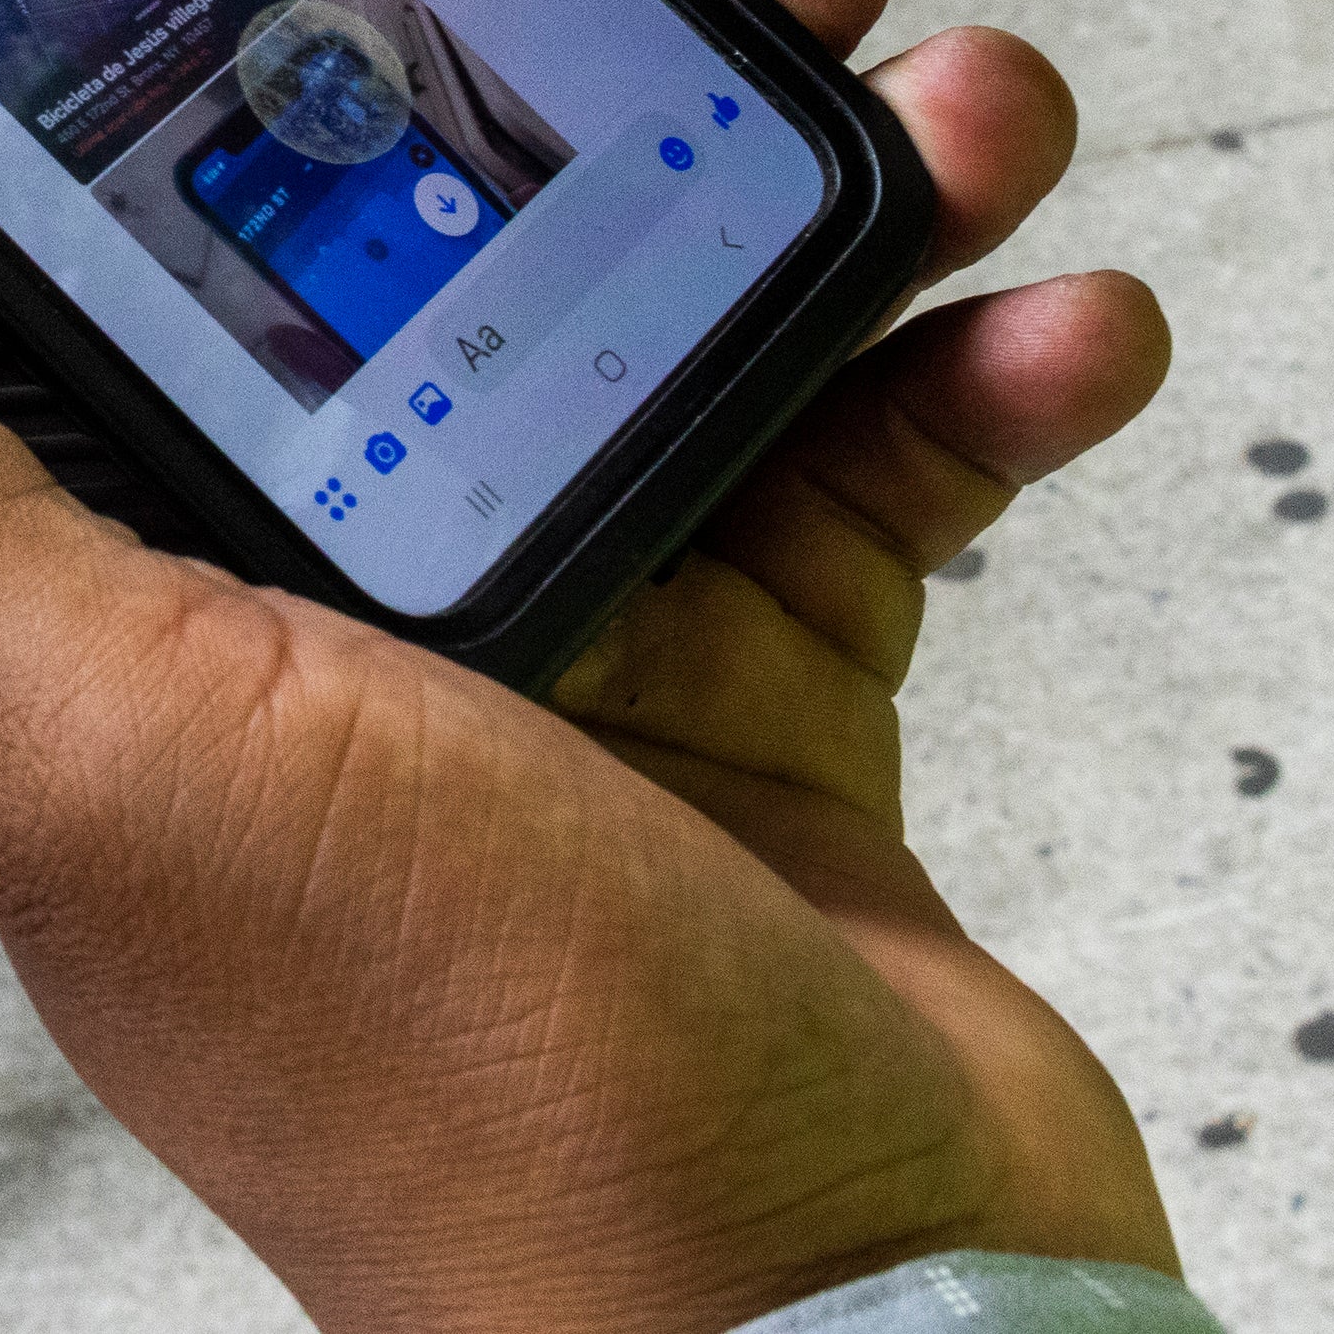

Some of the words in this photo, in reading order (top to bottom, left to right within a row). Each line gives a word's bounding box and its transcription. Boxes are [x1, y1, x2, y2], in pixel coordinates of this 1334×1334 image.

[37, 78, 105, 130] Bicicleta
[102, 62, 125, 82] de
[123, 28, 169, 66] Jesús
[456, 323, 505, 372] Aa
